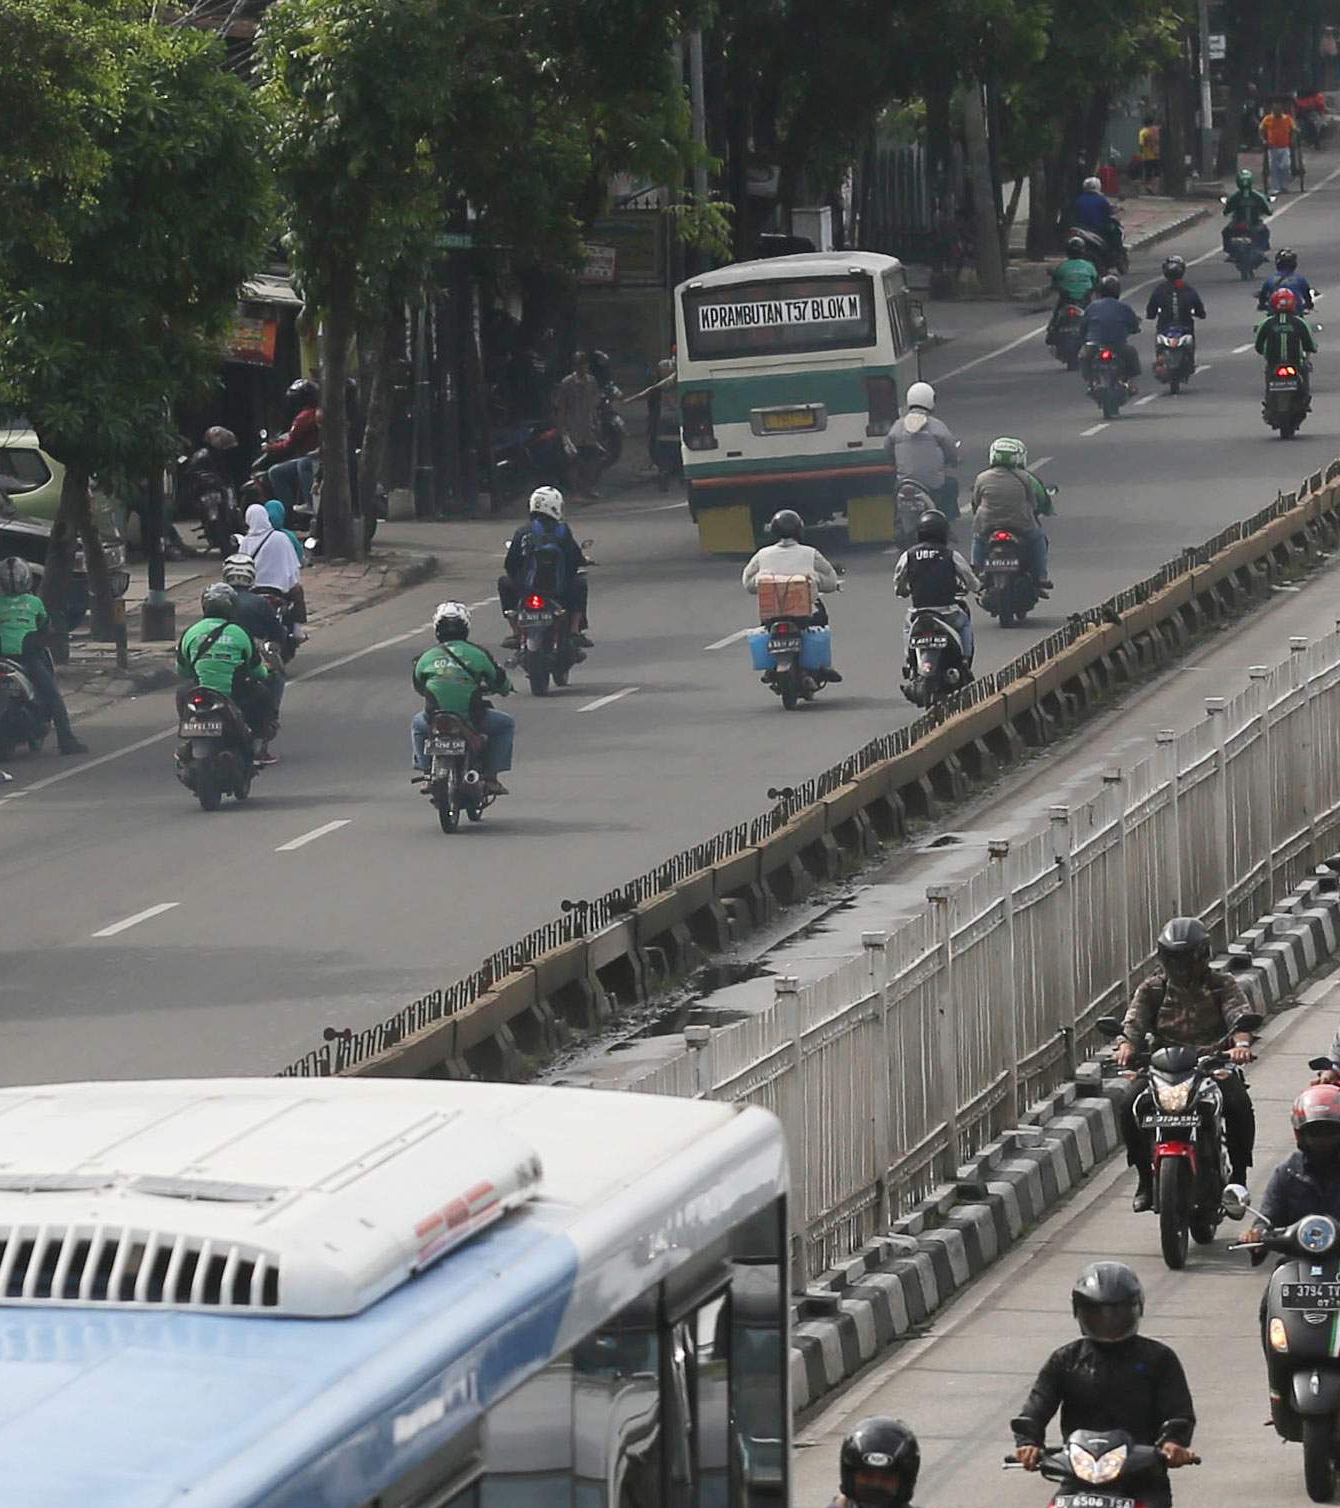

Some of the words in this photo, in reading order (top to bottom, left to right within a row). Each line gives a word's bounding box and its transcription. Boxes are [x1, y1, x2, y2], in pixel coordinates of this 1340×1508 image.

[1282, 1286, 1290, 1297] B
[1296, 1285, 1324, 1297] 3794
[1072, 1497, 1103, 1507] 6506
